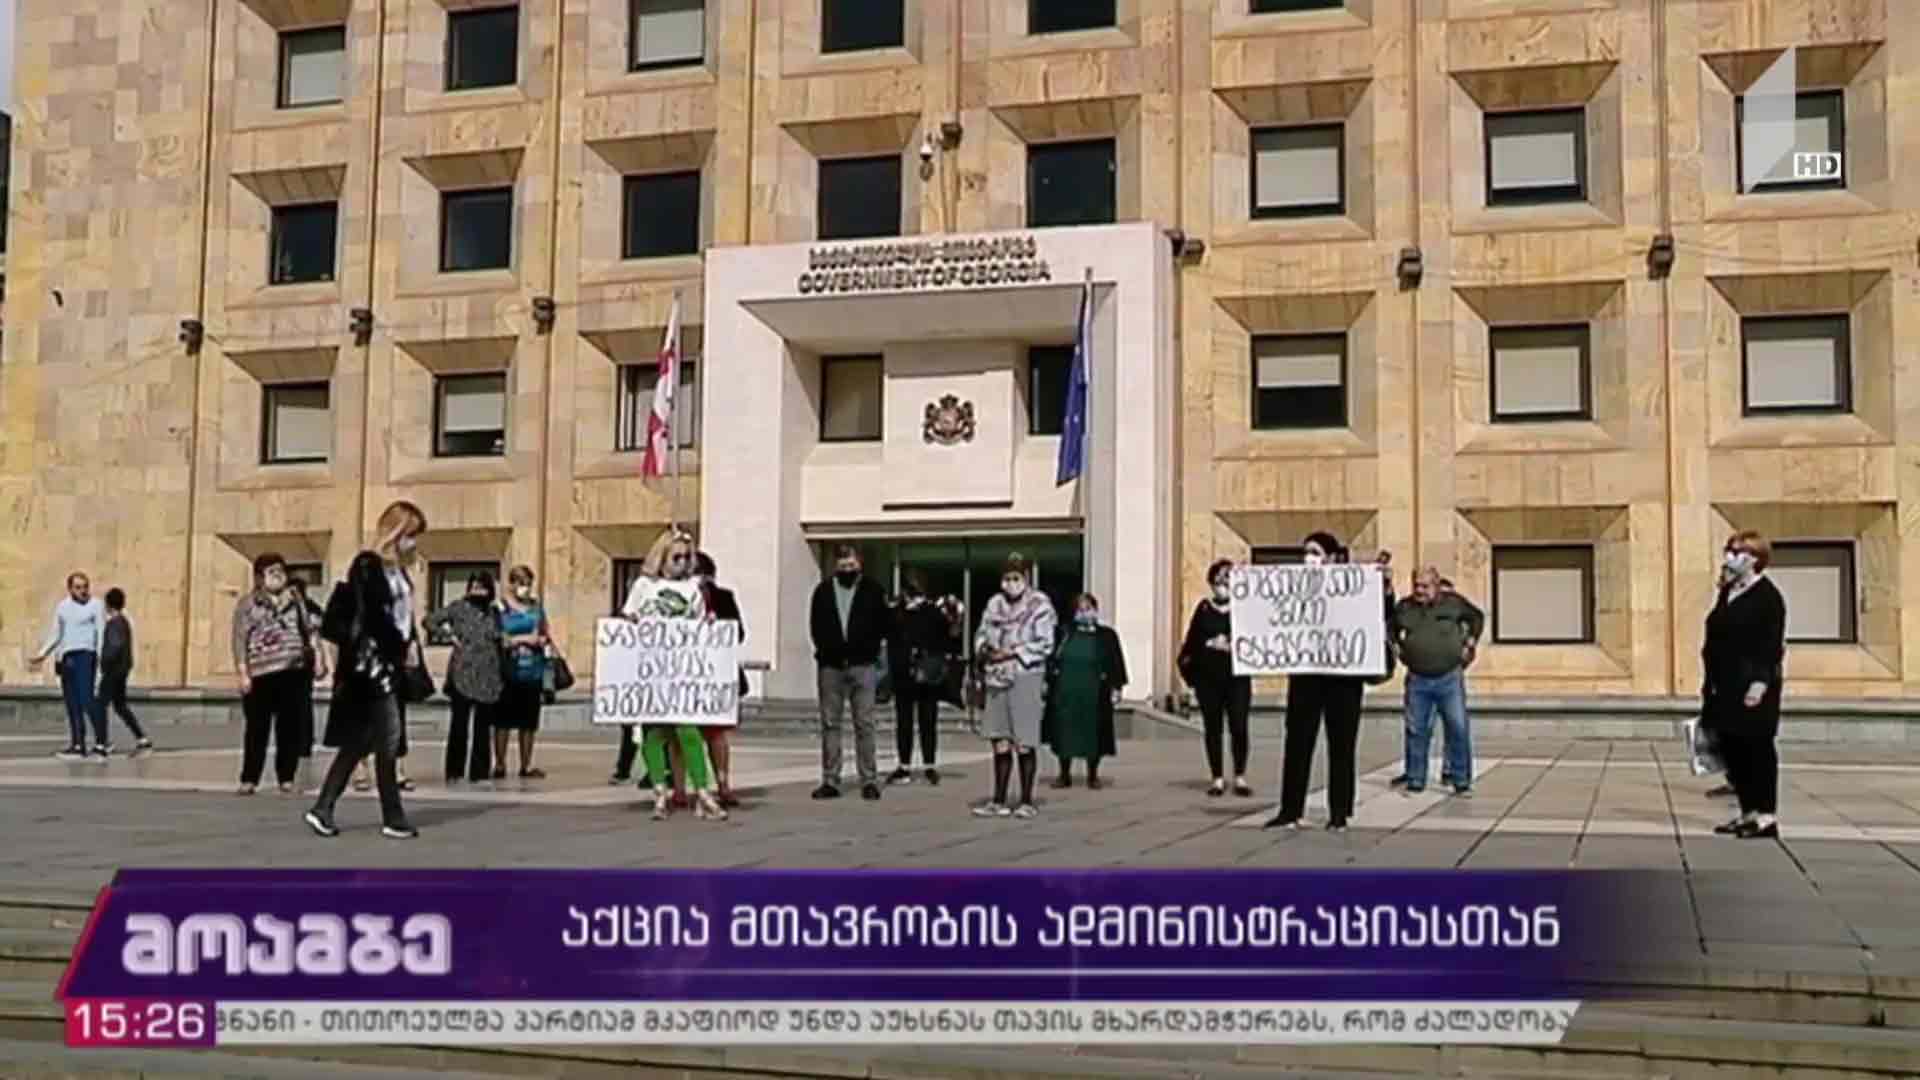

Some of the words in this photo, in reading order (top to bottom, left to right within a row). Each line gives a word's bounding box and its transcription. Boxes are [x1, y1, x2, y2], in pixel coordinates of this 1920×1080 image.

[798, 266, 929, 294] GOVERNMENT
[931, 265, 959, 287] OF
[960, 260, 1051, 286] GEORGIA
